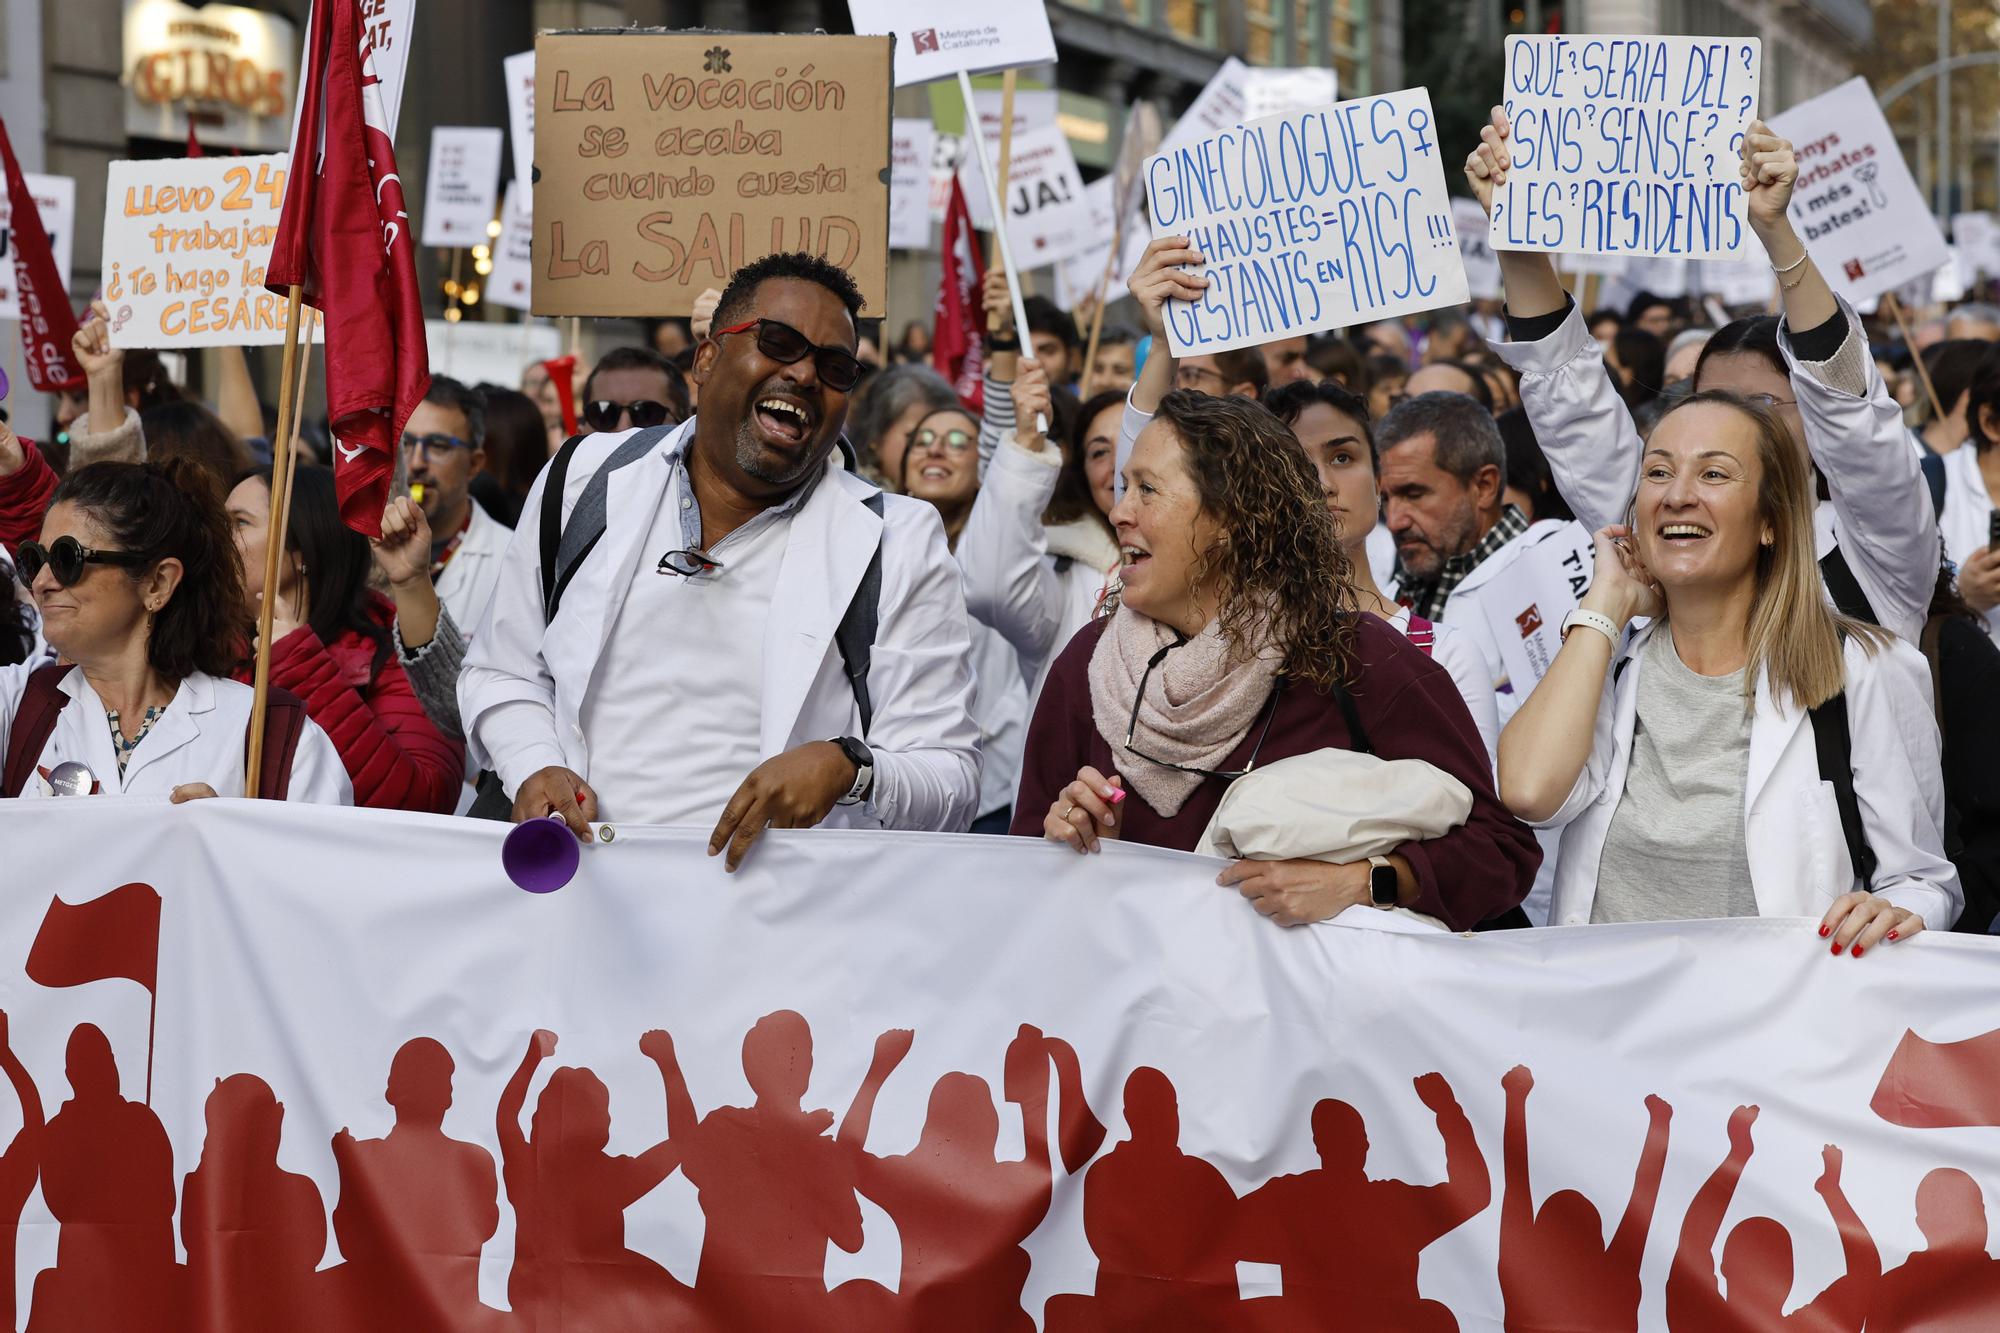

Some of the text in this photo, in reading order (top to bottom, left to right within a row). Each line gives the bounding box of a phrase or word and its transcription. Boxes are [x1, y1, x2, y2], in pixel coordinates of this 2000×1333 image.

[940, 26, 997, 40] Metges de
[943, 36, 1000, 50] Catalunya
[553, 70, 615, 112] La
[1583, 41, 1667, 103] SERIA
[578, 120, 782, 158] se acaba
[1794, 131, 1841, 164] enys
[221, 163, 286, 211] 24
[583, 163, 846, 200] cuando cuesta
[1792, 143, 1877, 194] orbates
[1012, 173, 1072, 216] JA!
[1508, 181, 1564, 248] LES
[1581, 180, 1742, 254] RESIDENTS
[1804, 199, 1873, 241] bates!
[548, 221, 609, 280] La
[166, 263, 230, 296] hago
[1167, 250, 1321, 347] GESTANTS
[1317, 258, 1344, 284] EN
